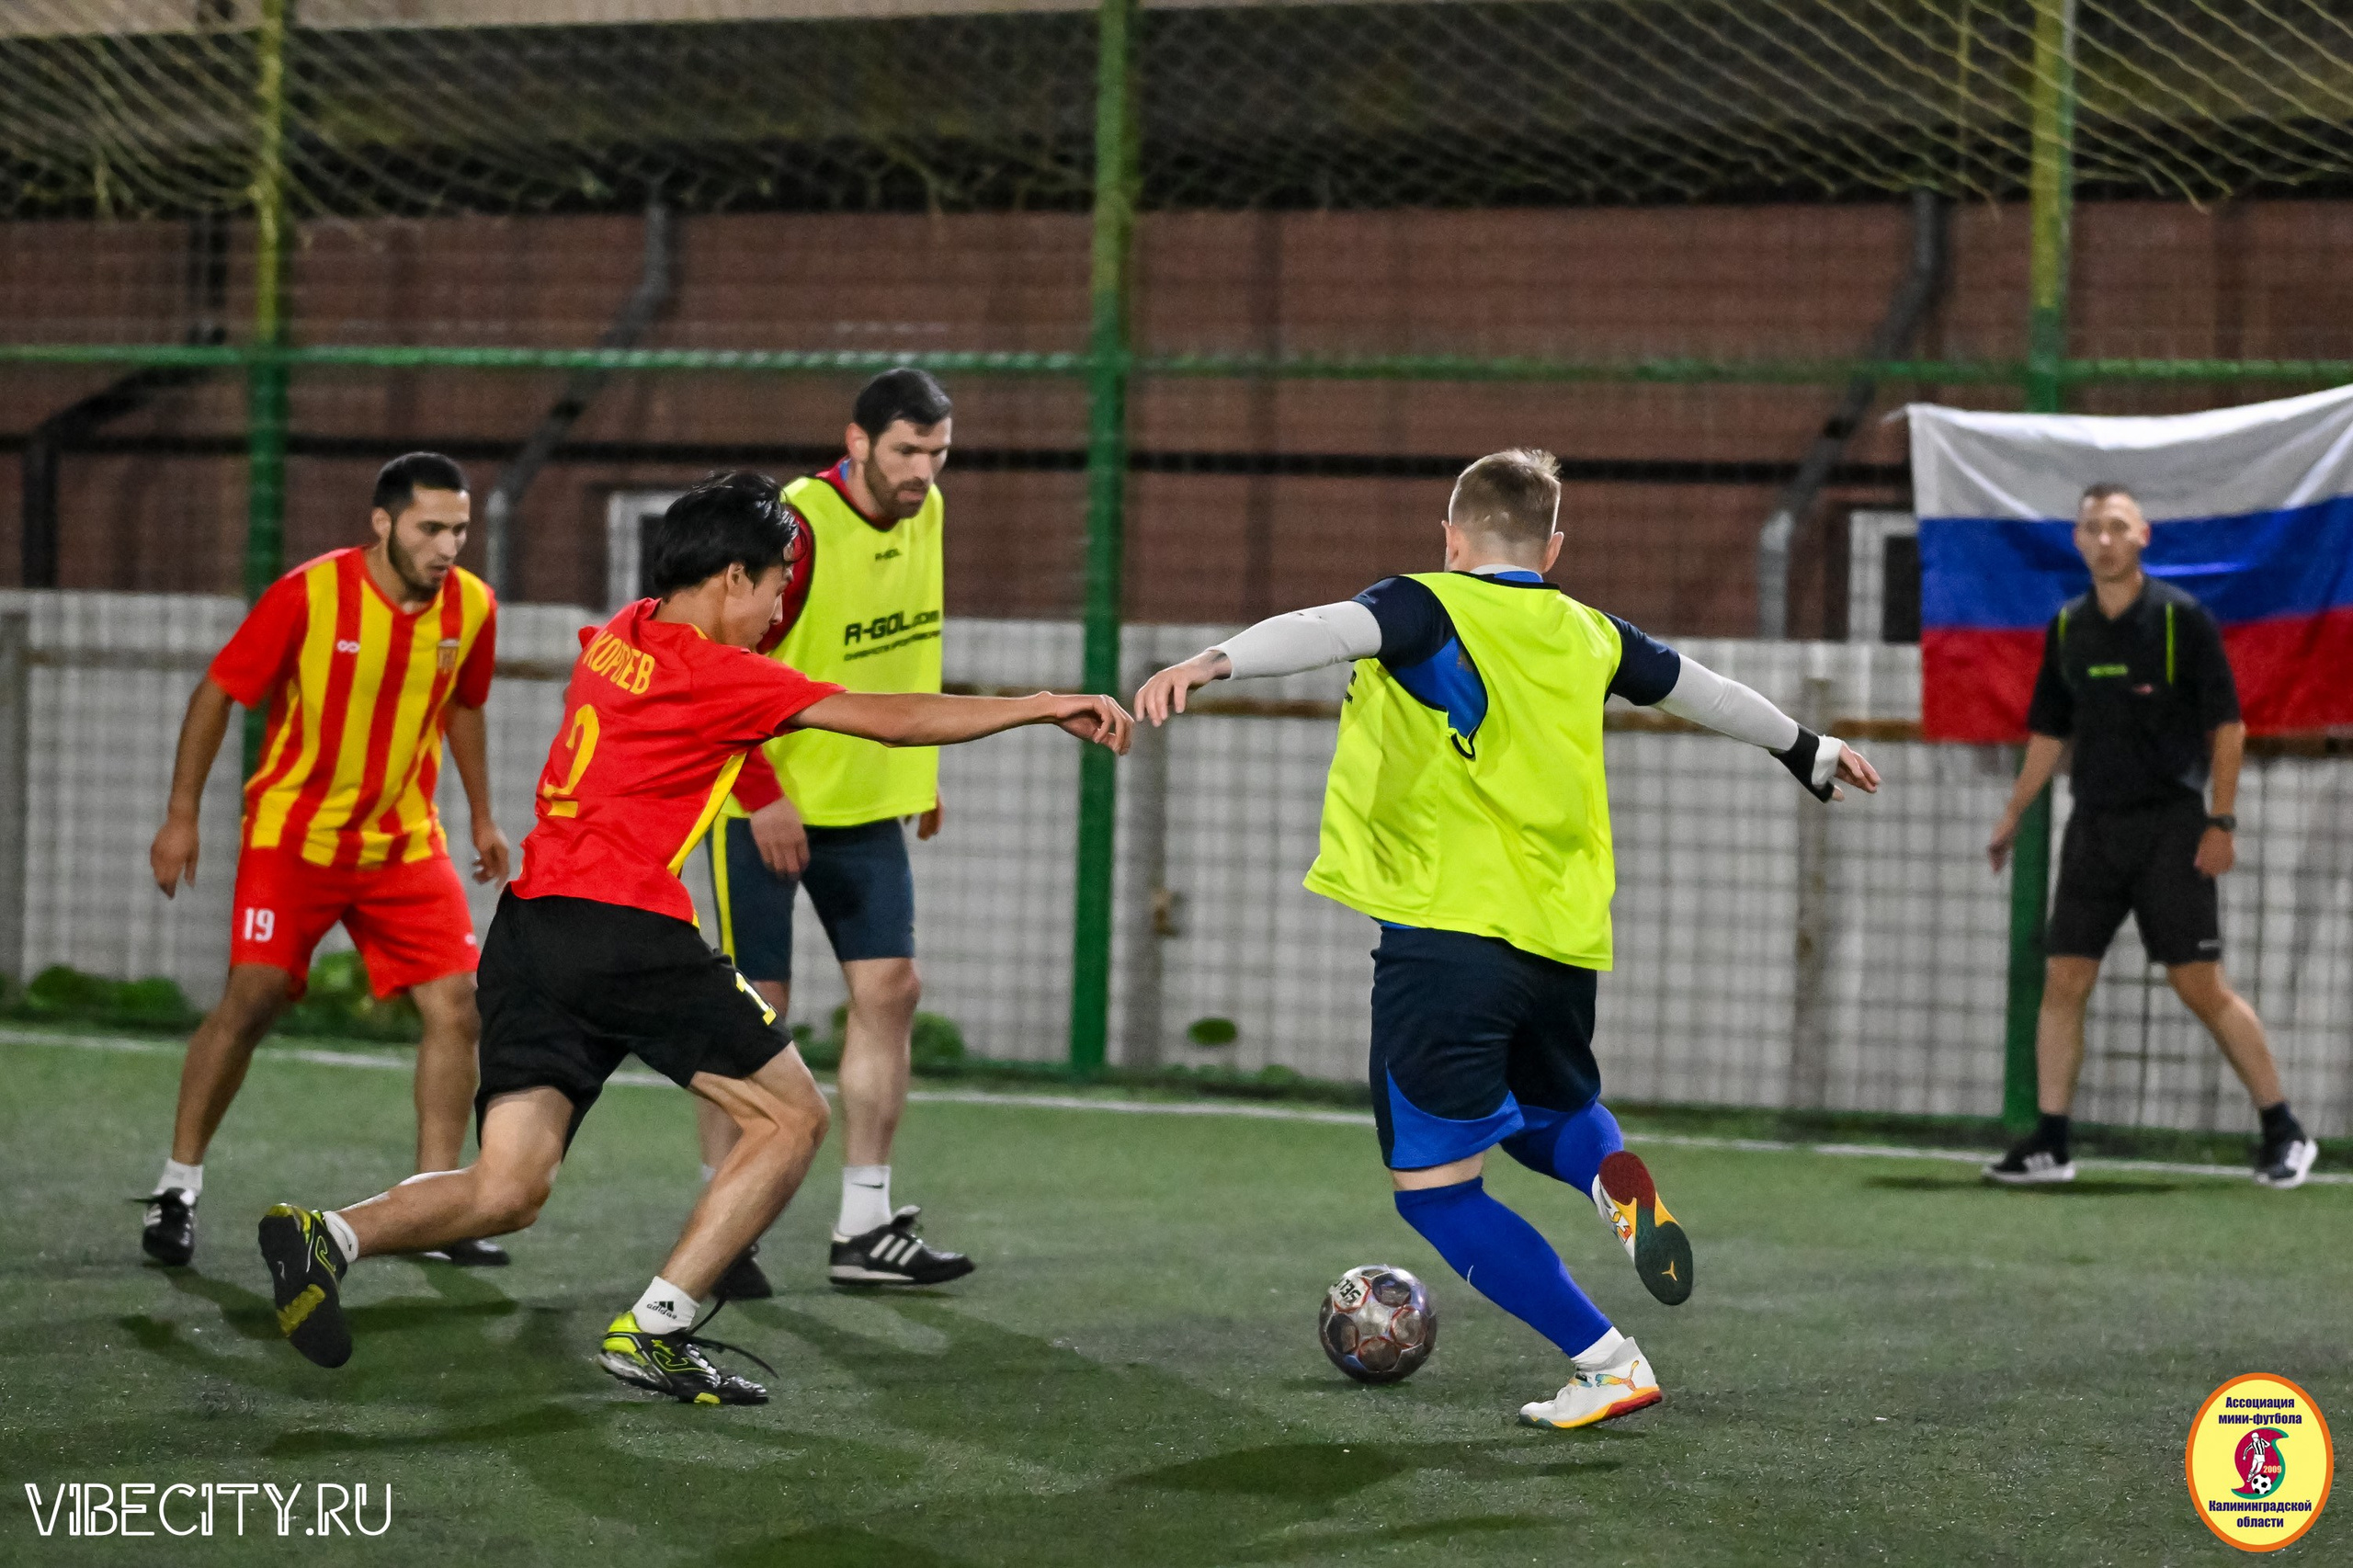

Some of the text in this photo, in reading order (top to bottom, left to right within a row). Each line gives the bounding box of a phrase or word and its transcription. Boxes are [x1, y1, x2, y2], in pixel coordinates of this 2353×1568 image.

[542, 703, 600, 819] 2
[244, 907, 276, 942] 19
[646, 1302, 678, 1320] adidas
